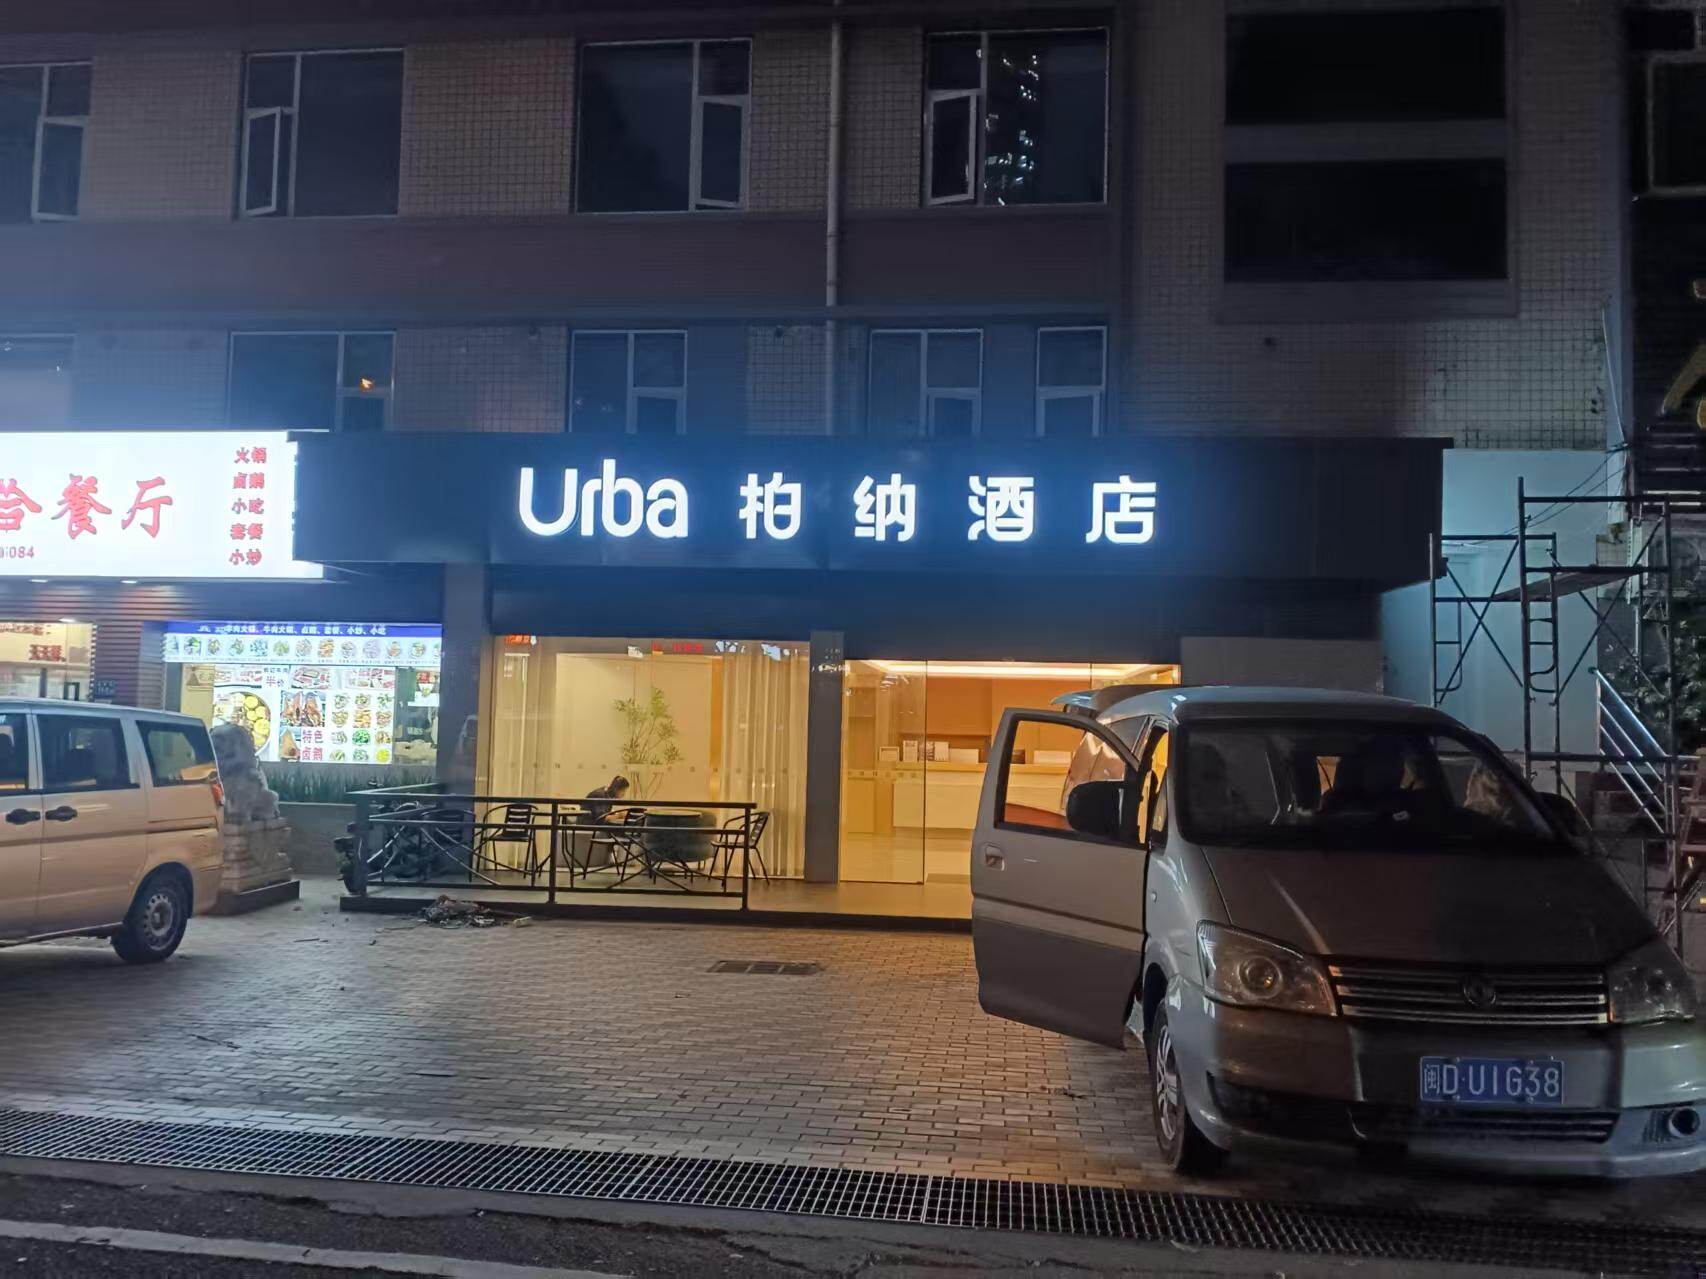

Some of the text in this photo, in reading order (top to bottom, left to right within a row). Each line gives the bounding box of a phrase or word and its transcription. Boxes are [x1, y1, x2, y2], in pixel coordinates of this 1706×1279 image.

[231, 498, 264, 515] 小吃
[518, 458, 1157, 544] Urba 柏纳酒店
[229, 549, 262, 566] 小炒
